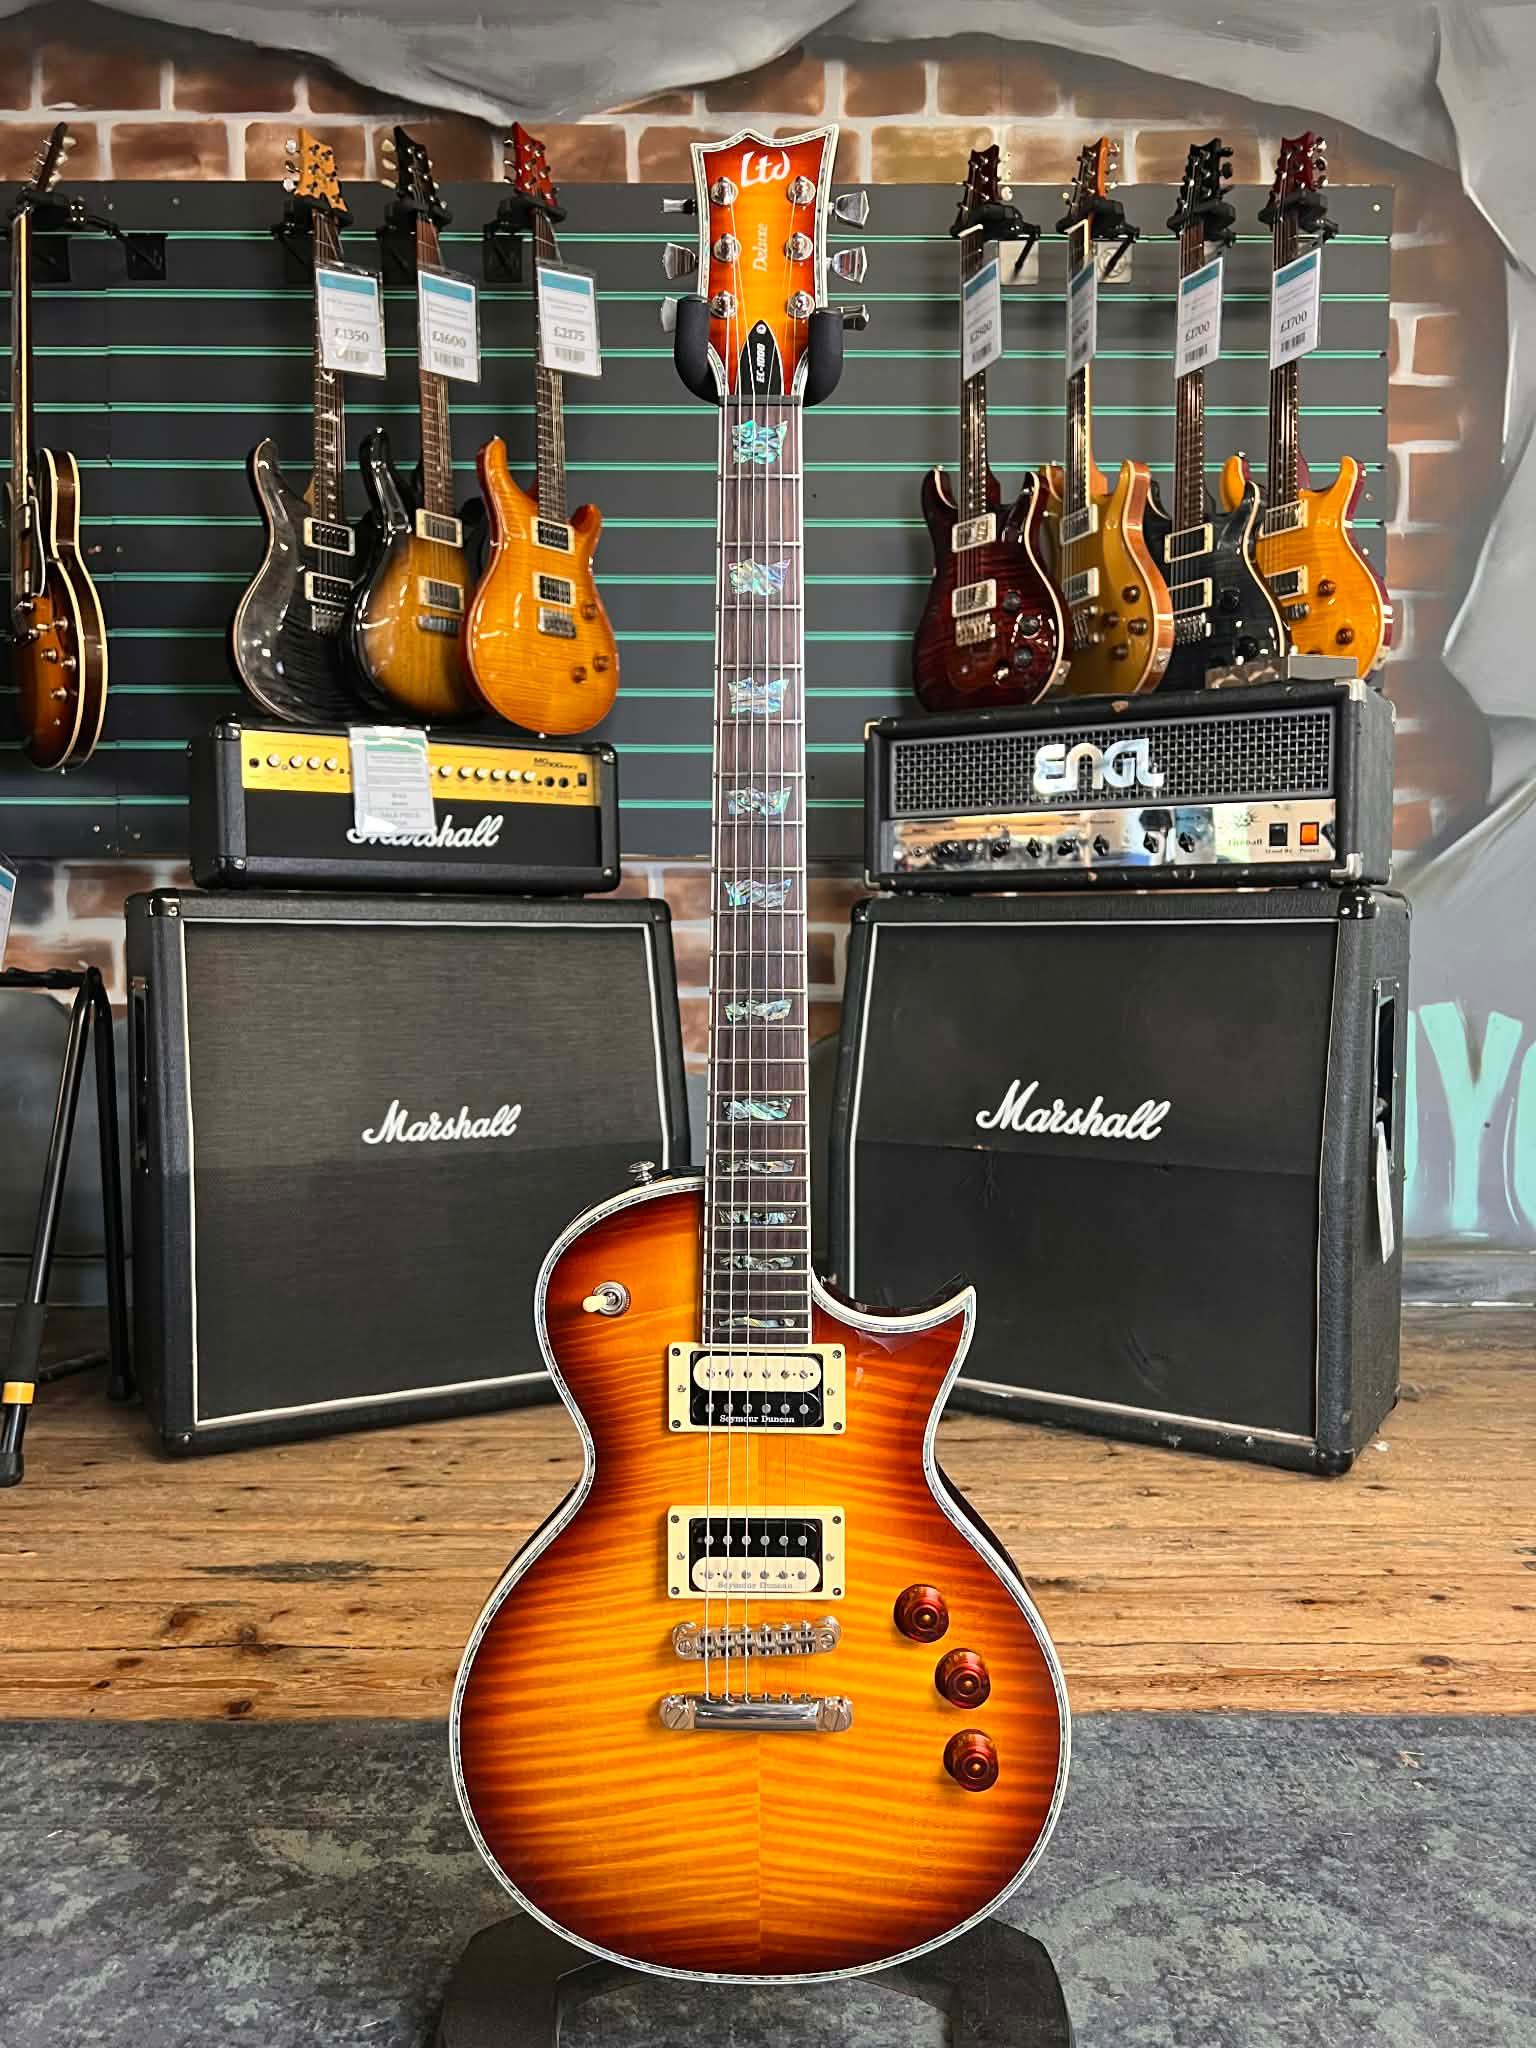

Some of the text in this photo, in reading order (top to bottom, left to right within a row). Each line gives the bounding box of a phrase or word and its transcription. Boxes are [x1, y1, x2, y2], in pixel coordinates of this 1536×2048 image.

[741, 151, 790, 187] Ltd
[752, 223, 769, 272] Deluxe
[1280, 310, 1309, 333] £1700
[756, 343, 766, 384] EC-1000
[1033, 738, 1164, 794] ENGL
[362, 1099, 522, 1144] Marshall
[975, 1079, 1171, 1141] Marshall
[720, 1414, 795, 1424] Seymour Duncan
